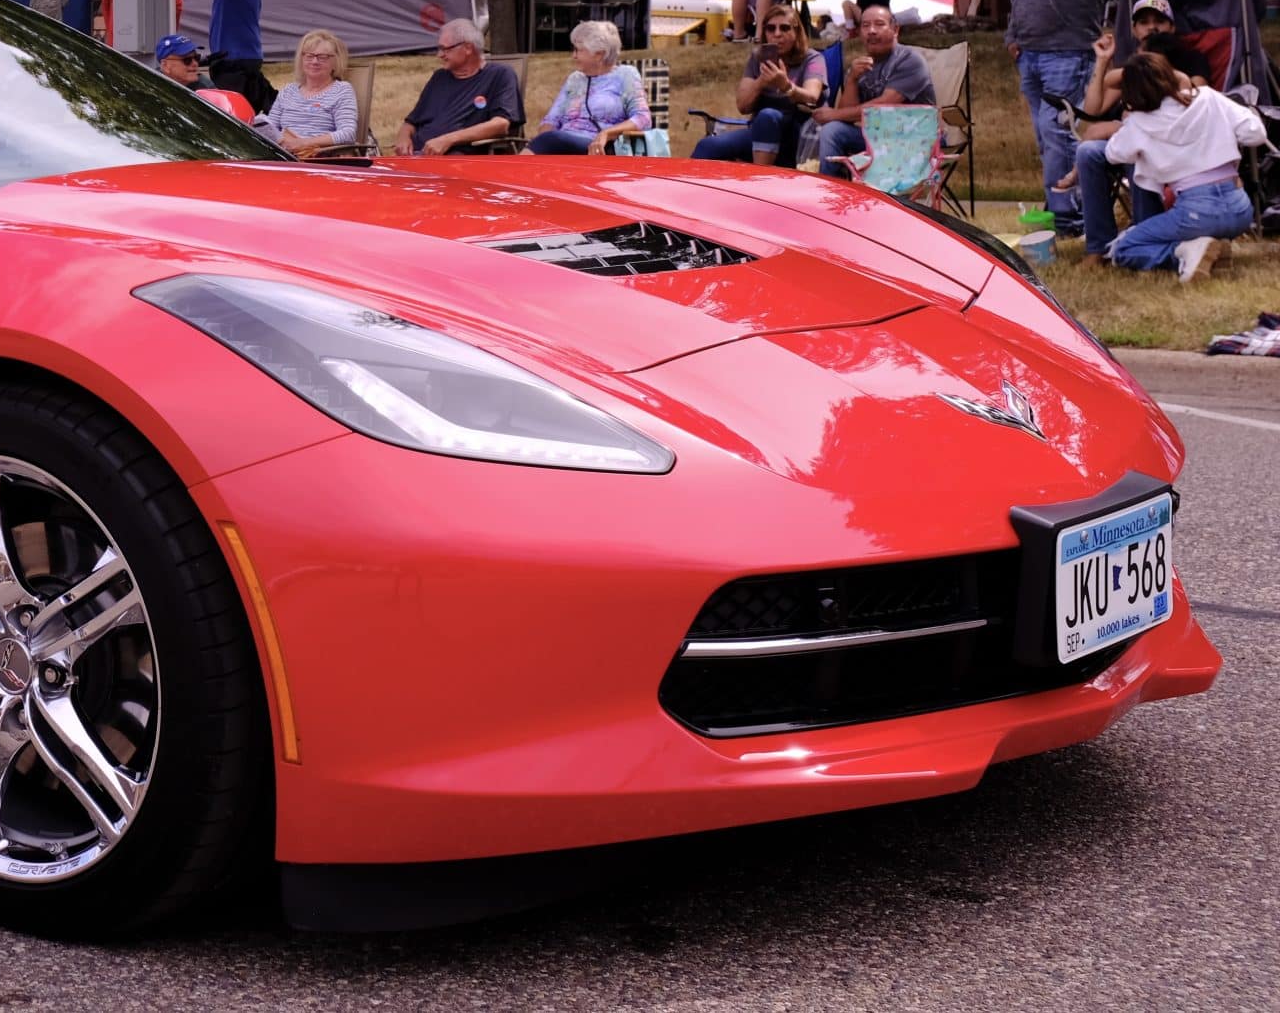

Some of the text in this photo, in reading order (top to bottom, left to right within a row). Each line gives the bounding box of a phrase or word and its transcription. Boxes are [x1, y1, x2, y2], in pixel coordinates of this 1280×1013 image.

[1065, 532, 1166, 628] JKU 568
[1097, 614, 1140, 639] 10,000 lakes
[1066, 632, 1080, 654] SEP
